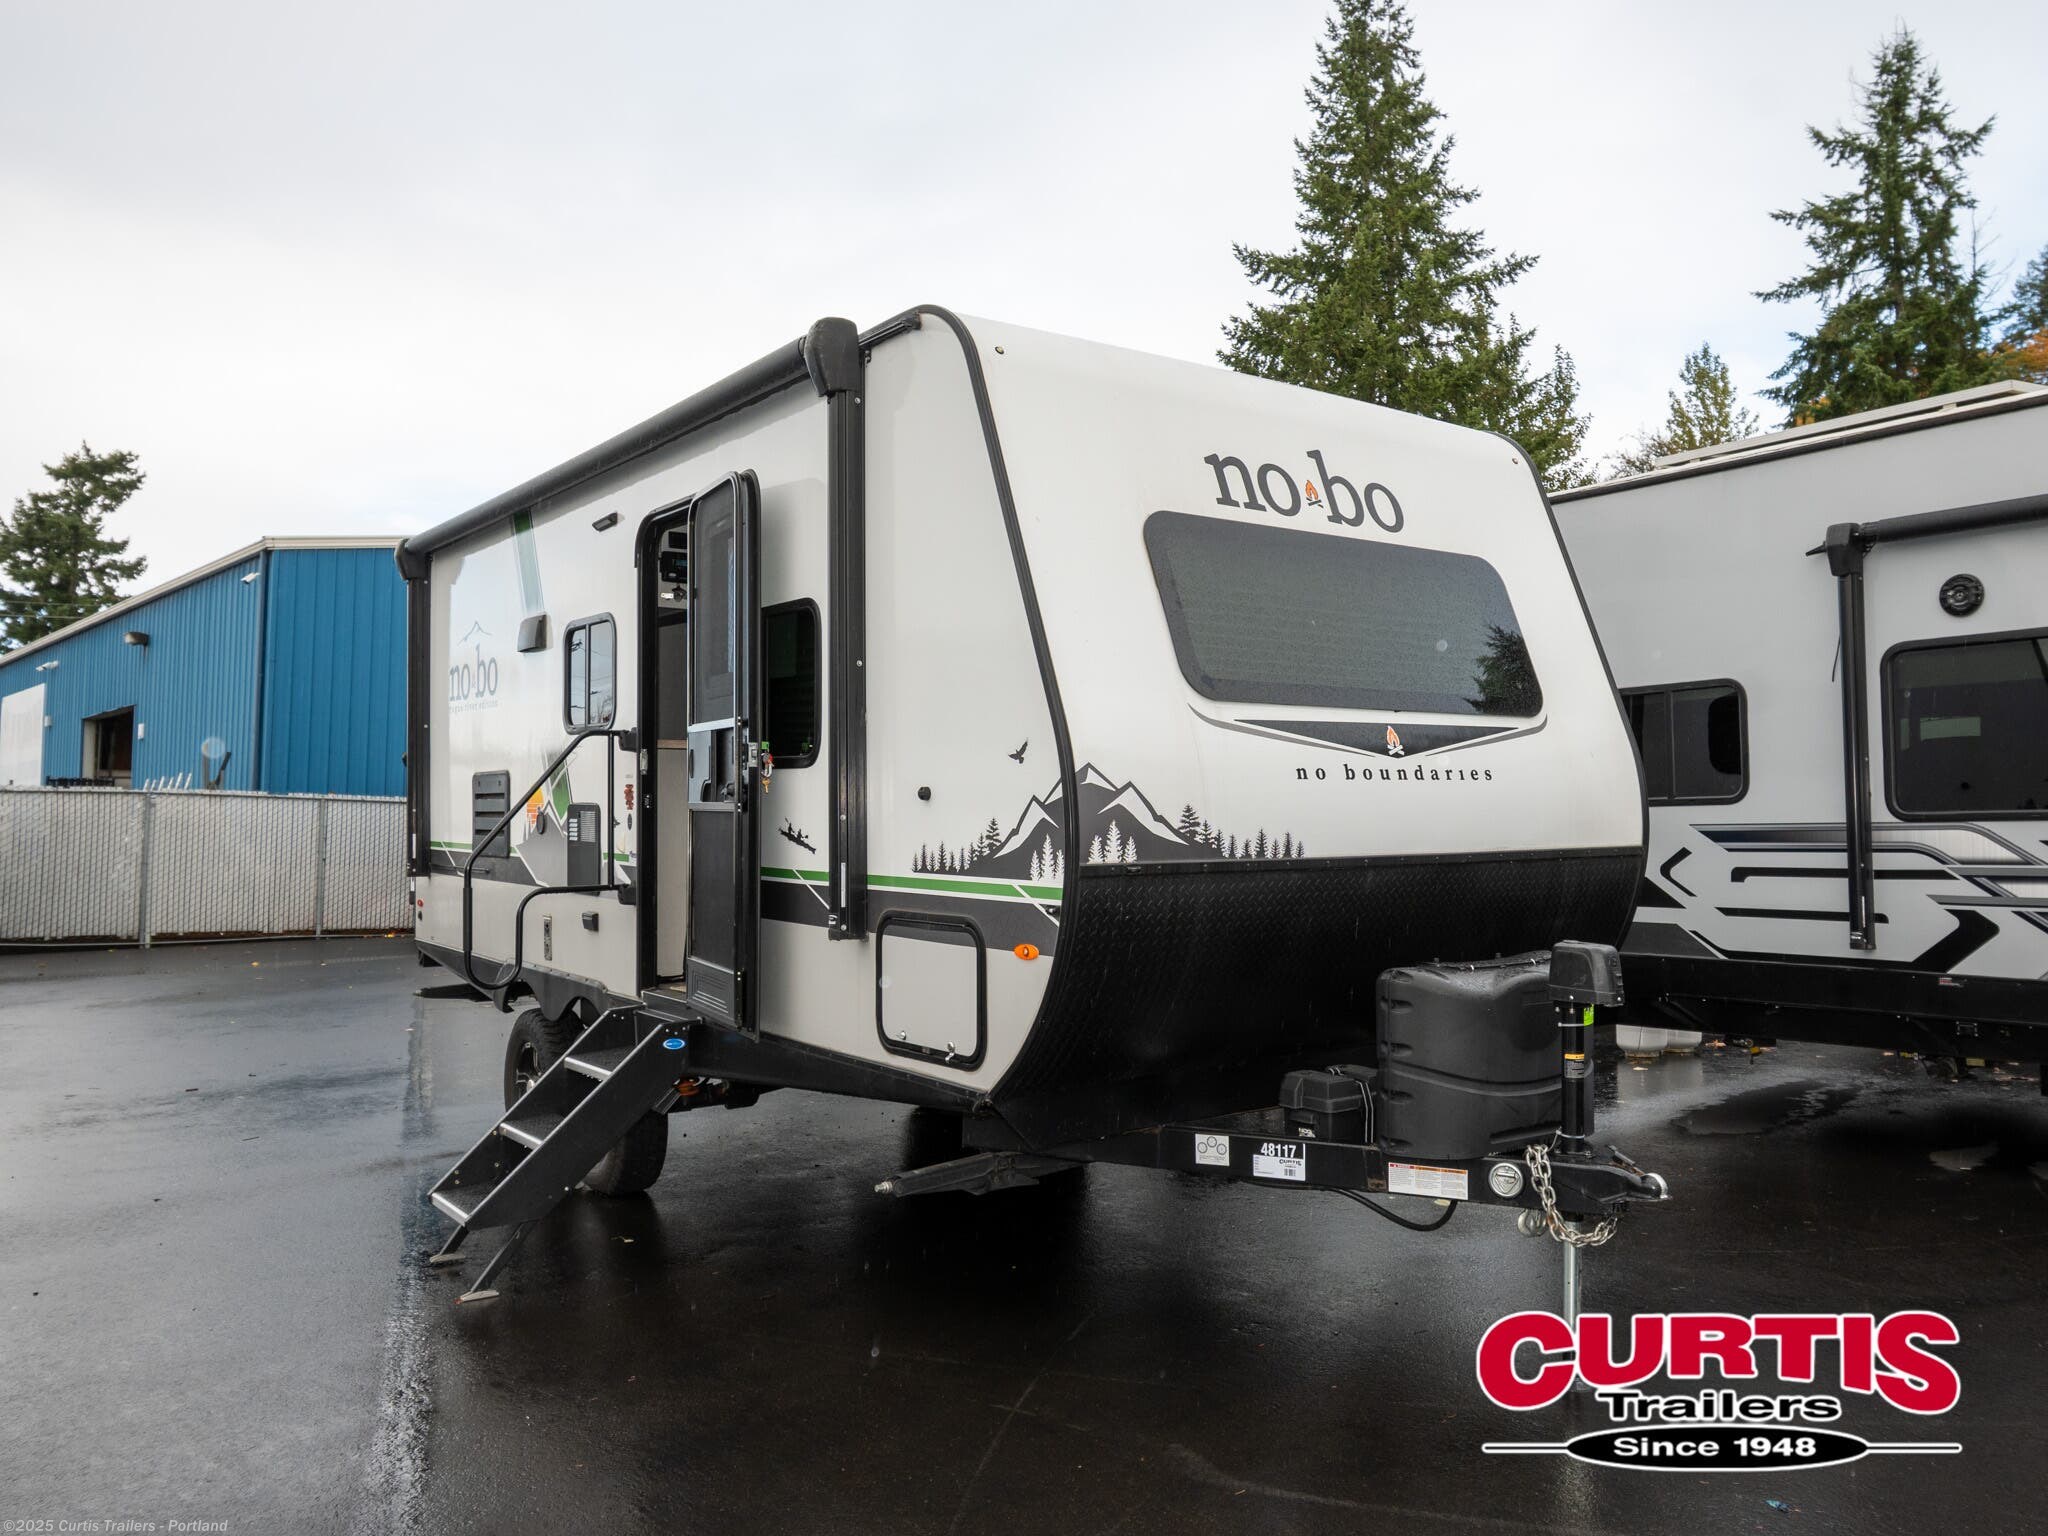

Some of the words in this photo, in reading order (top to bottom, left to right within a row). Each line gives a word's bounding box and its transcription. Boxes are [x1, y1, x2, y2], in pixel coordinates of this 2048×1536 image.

[1296, 767, 1326, 780] no
[1343, 764, 1493, 780] boundaries
[1260, 1142, 1297, 1159] 48117
